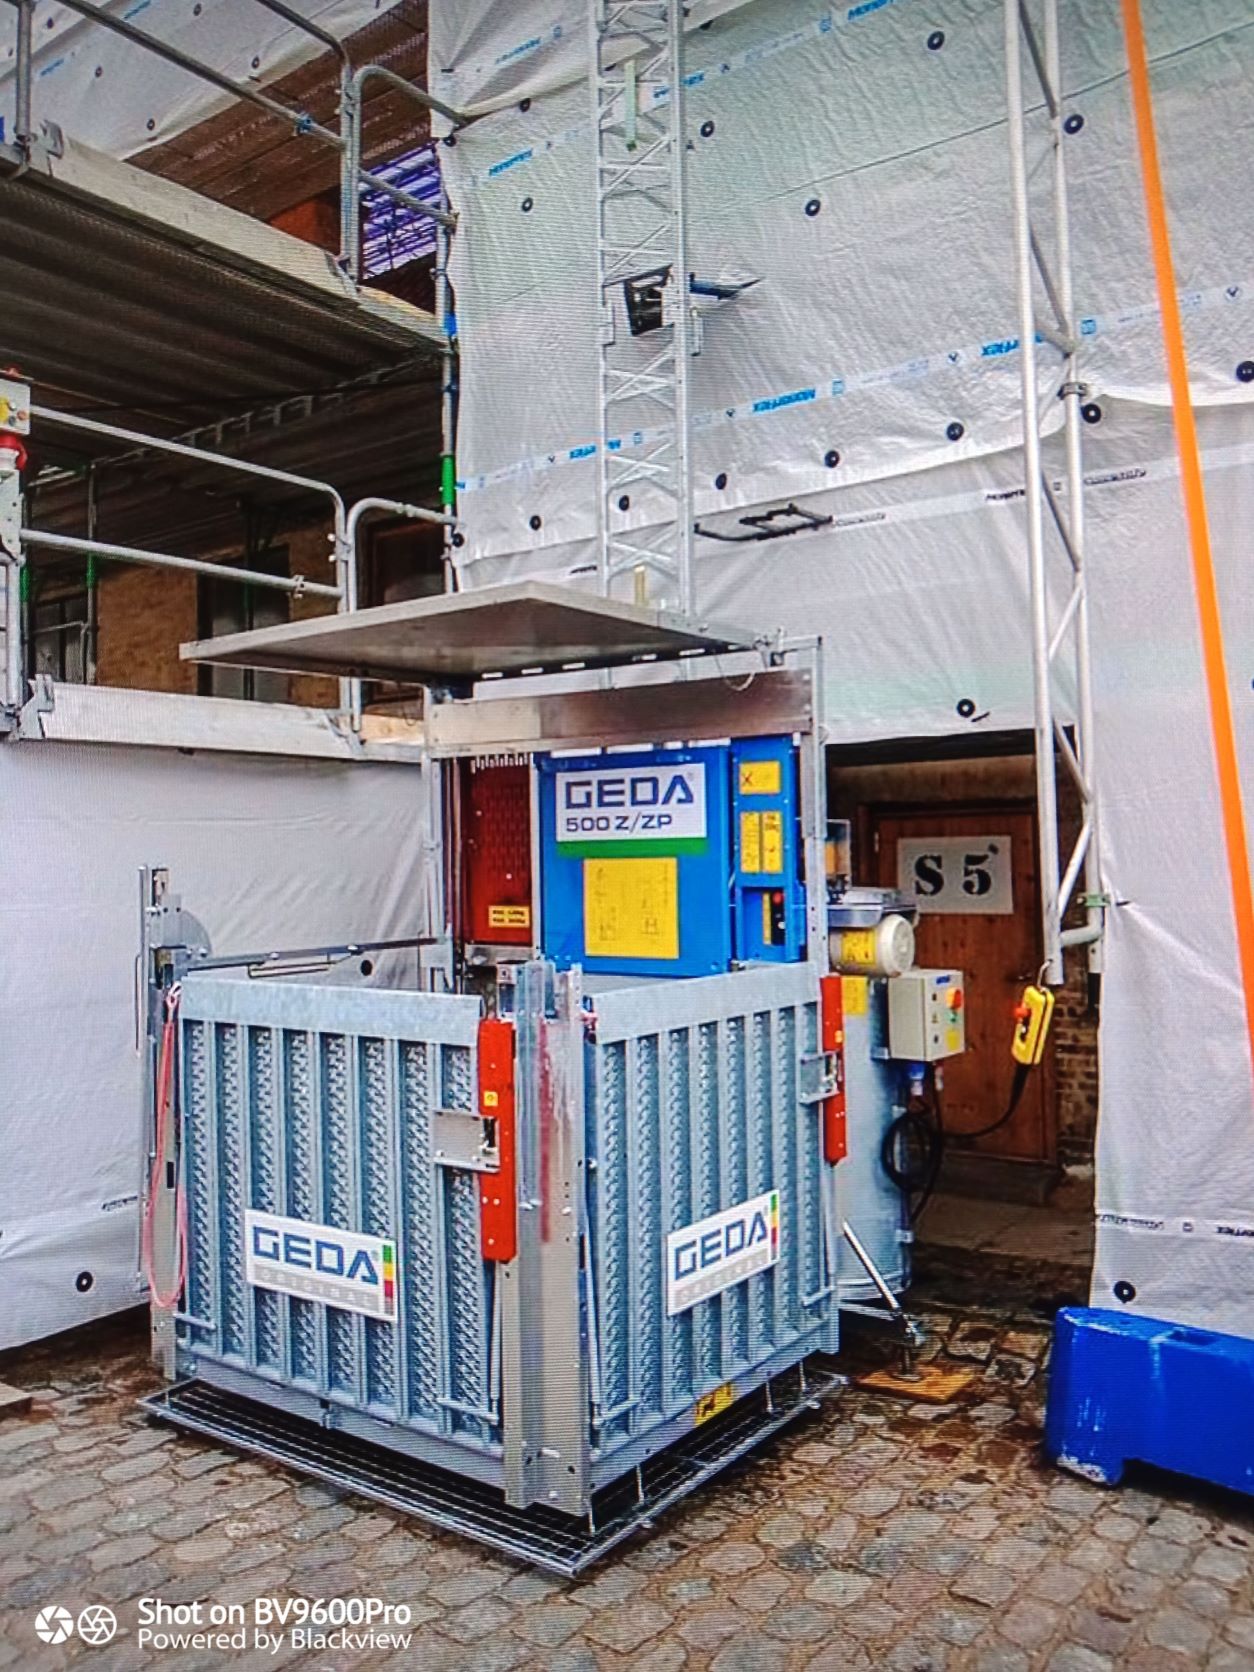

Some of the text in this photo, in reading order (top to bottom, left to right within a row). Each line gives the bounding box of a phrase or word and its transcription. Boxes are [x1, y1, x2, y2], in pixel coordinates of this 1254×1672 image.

[565, 775, 694, 809] GEDA
[566, 812, 672, 833] 500 Z/ZP
[914, 844, 998, 896] S 5
[253, 1226, 378, 1285] GEDA
[675, 1211, 768, 1280] GEDA
